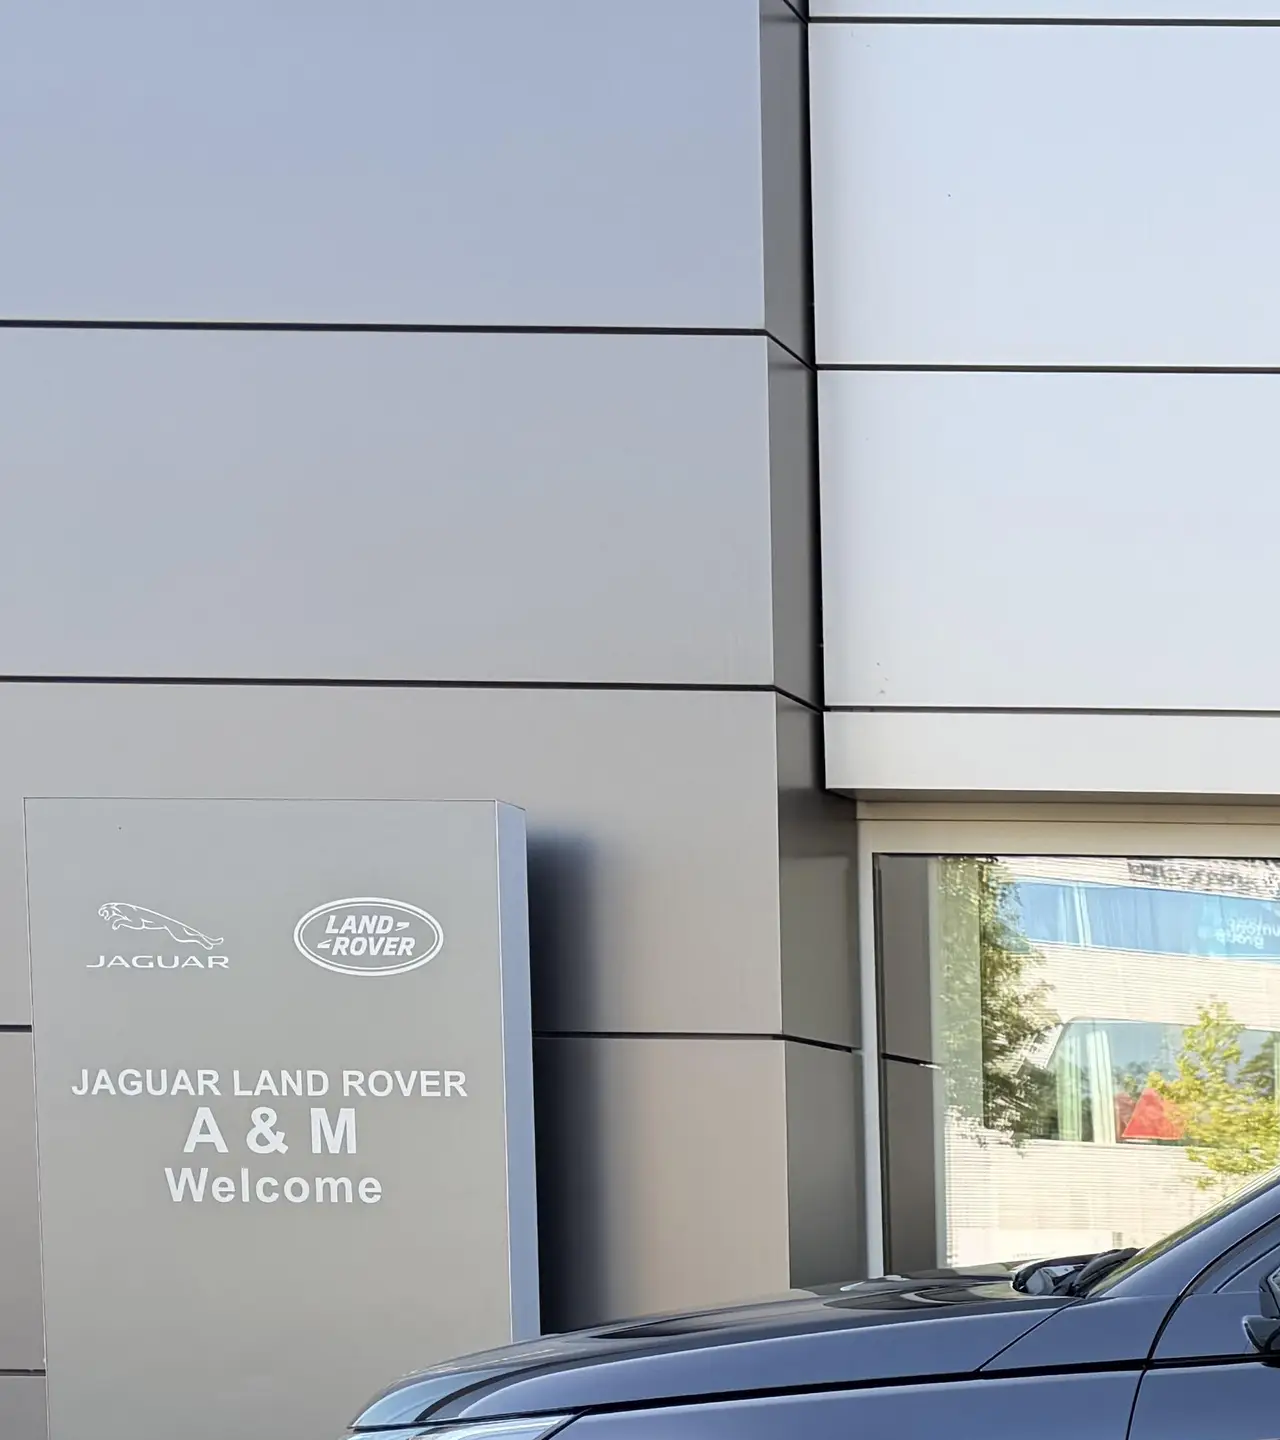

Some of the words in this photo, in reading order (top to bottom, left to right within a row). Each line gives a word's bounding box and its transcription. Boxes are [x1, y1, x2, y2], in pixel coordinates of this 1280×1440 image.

[324, 914, 391, 935] LAND
[332, 936, 416, 957] ROVER
[87, 955, 229, 969] JAGUAR
[71, 1068, 221, 1096] JAGUAR
[233, 1069, 329, 1096] LAND
[343, 1070, 468, 1097] ROVER
[183, 1106, 229, 1153] A
[246, 1106, 289, 1154] &
[311, 1107, 357, 1154] M
[165, 1167, 382, 1203] Welcome
